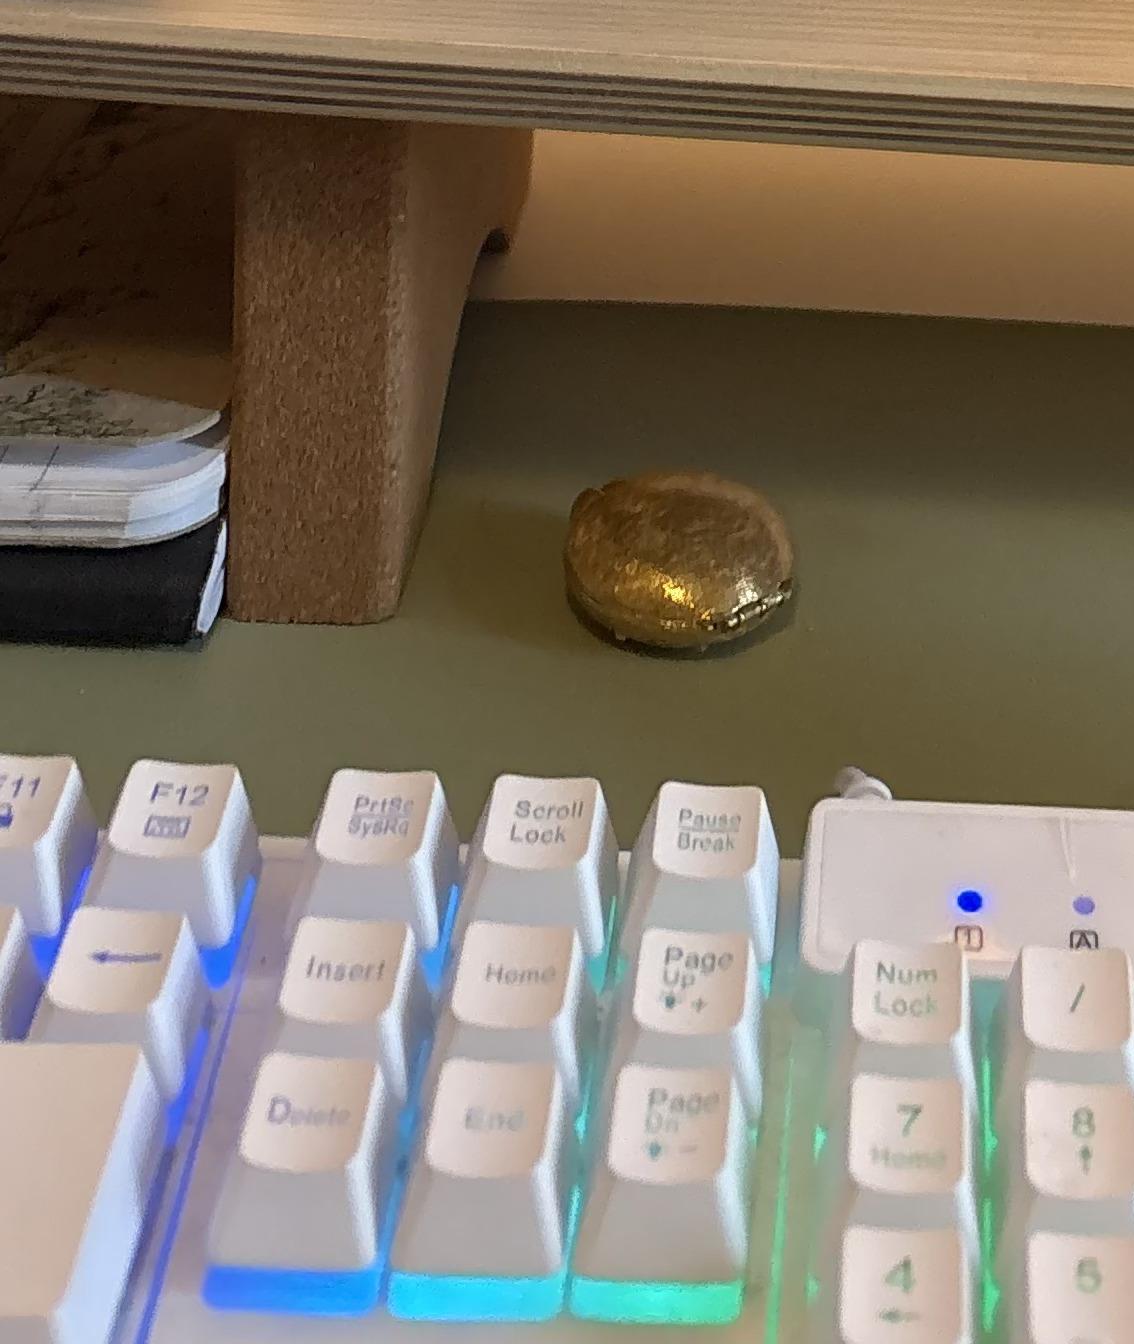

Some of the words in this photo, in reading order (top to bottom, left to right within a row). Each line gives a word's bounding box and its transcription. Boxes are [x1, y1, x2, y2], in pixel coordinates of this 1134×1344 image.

[150, 781, 209, 807] F12
[514, 798, 585, 820] Scroll
[678, 806, 742, 829] Pause
[510, 824, 566, 845] Lock
[677, 832, 735, 852] Break
[305, 955, 386, 983] Insert
[663, 945, 735, 973] Page
[485, 962, 557, 985] Home
[661, 970, 698, 992] Up
[876, 961, 938, 985] Num
[873, 991, 938, 1018] Lock
[647, 1087, 721, 1116] Page
[897, 1104, 924, 1137] 7
[1072, 1106, 1097, 1139] 8
[884, 1254, 916, 1294] 4
